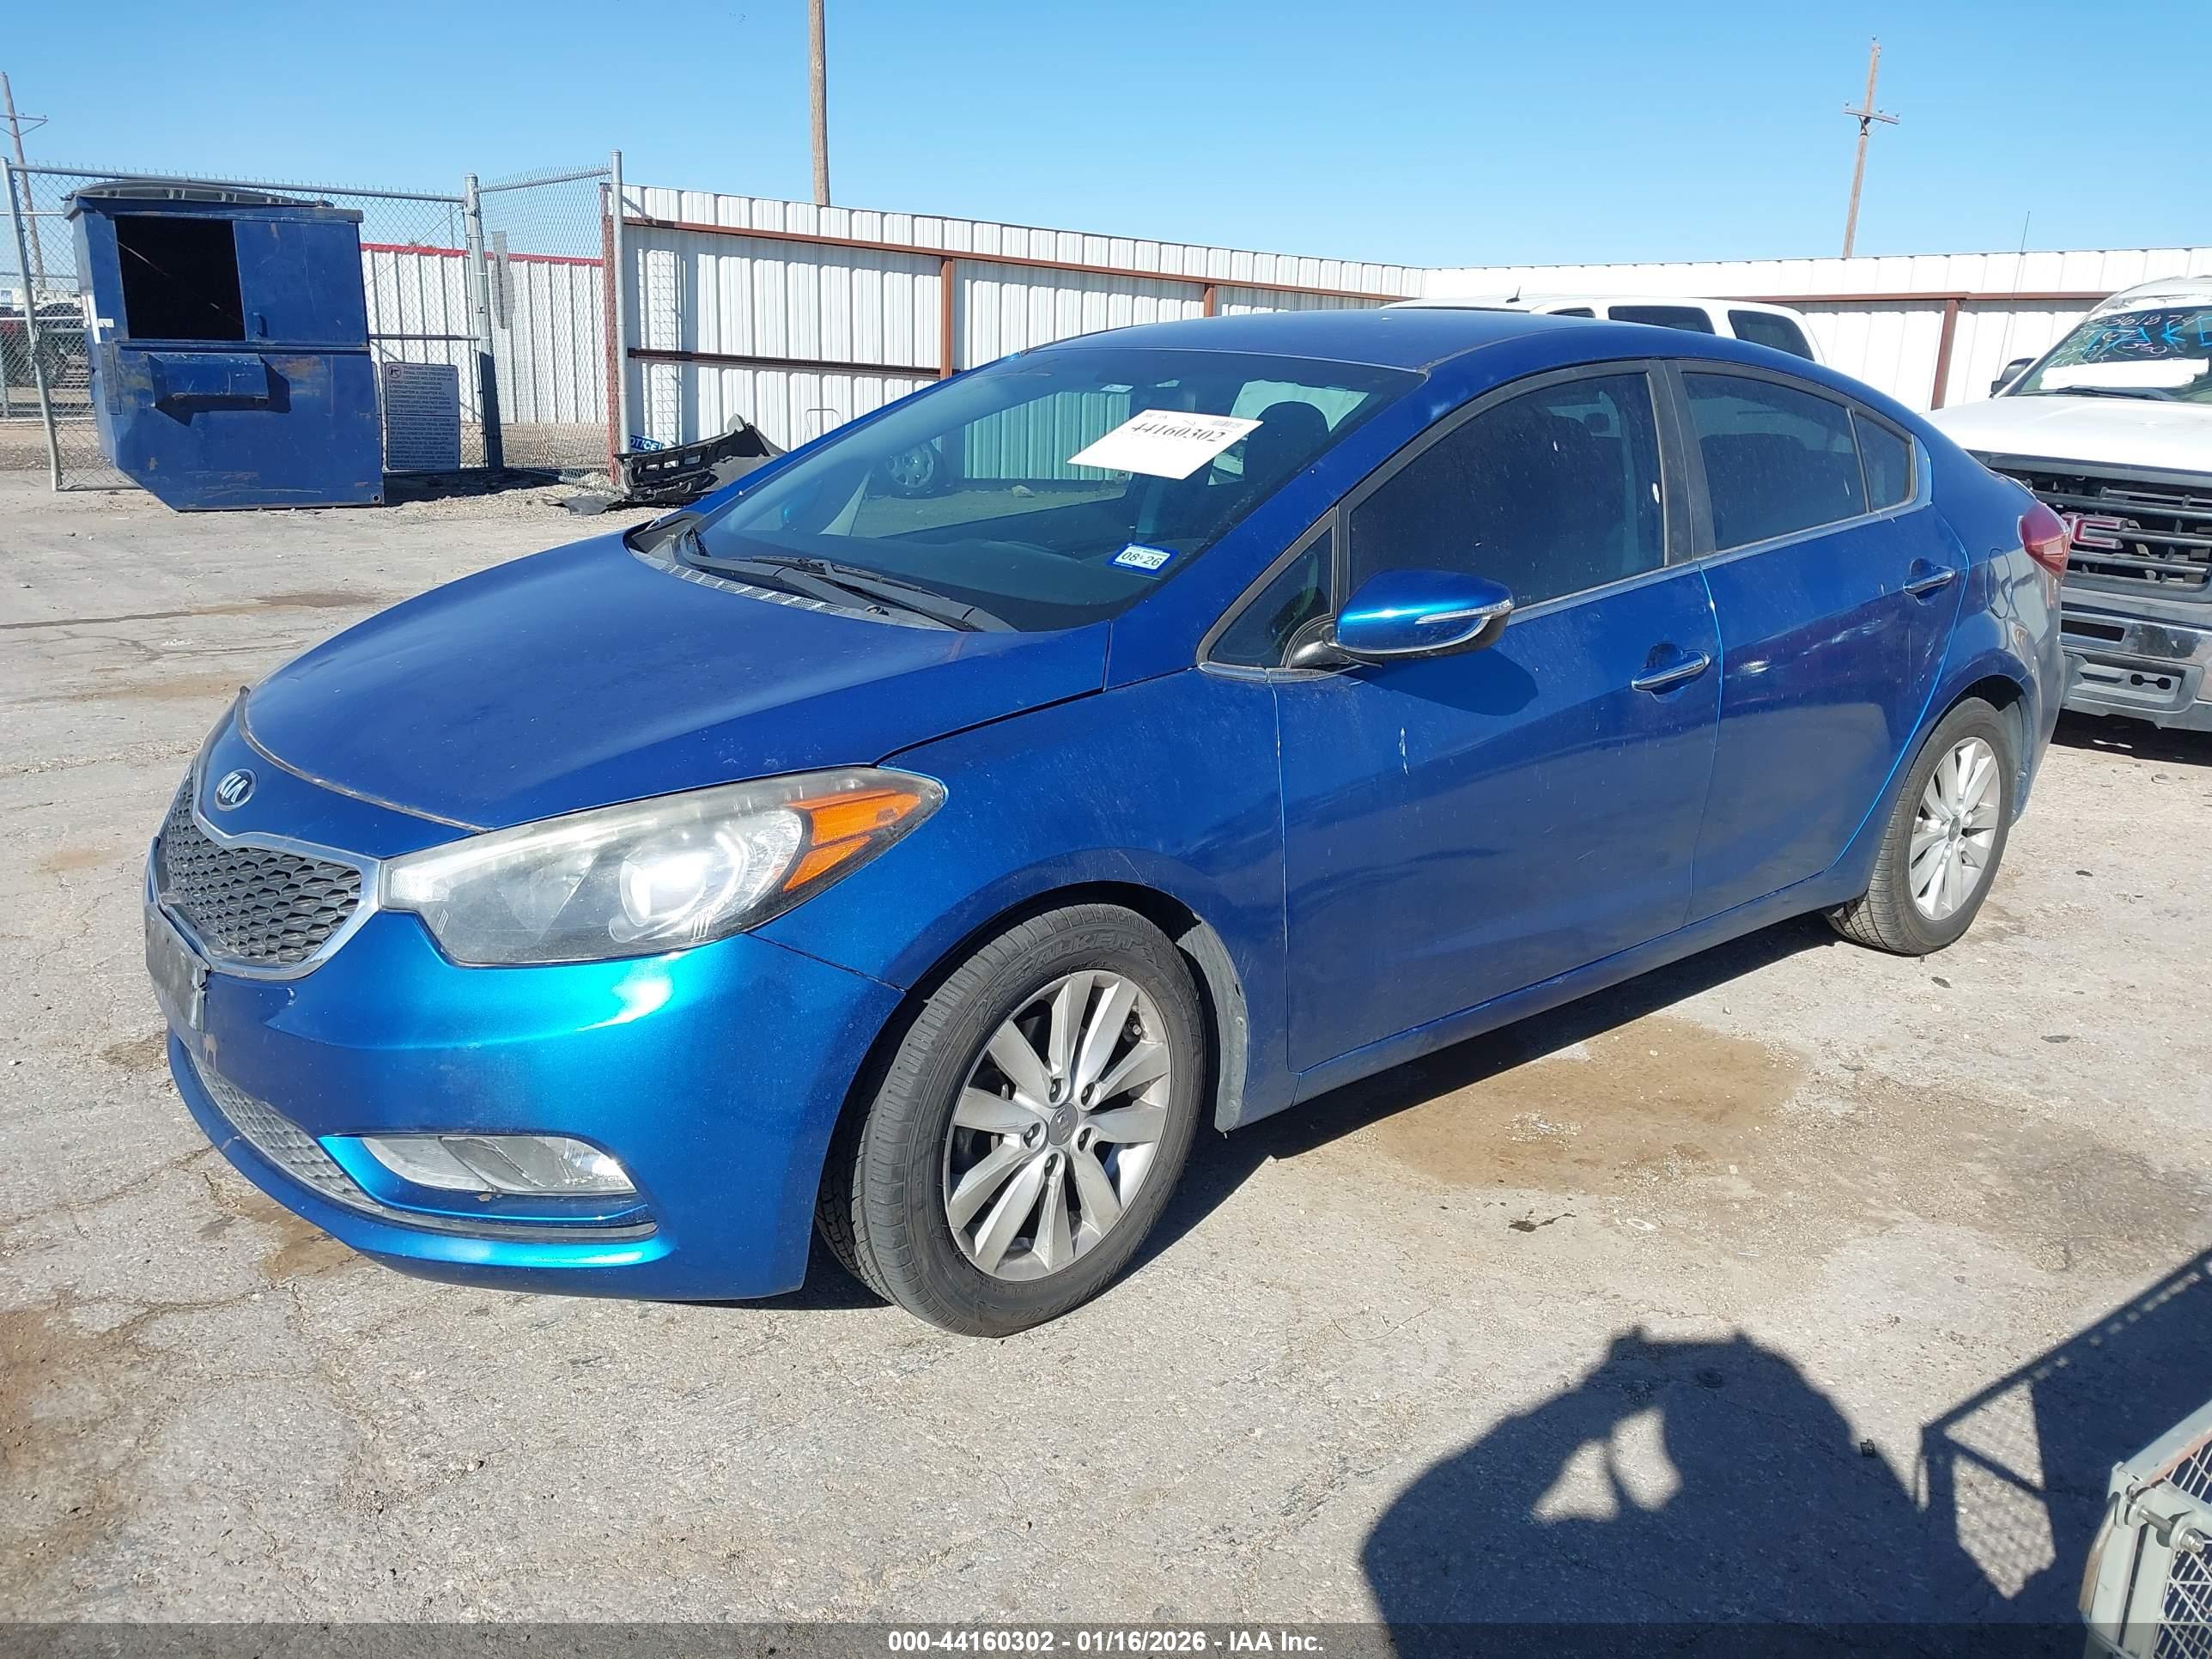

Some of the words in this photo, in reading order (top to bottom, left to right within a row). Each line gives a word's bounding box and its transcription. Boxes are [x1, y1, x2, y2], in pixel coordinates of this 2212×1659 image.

[1131, 422, 1227, 442] 44160302
[630, 436, 659, 452] OTICE
[1121, 551, 1140, 562] 08
[1141, 556, 1164, 567] 26
